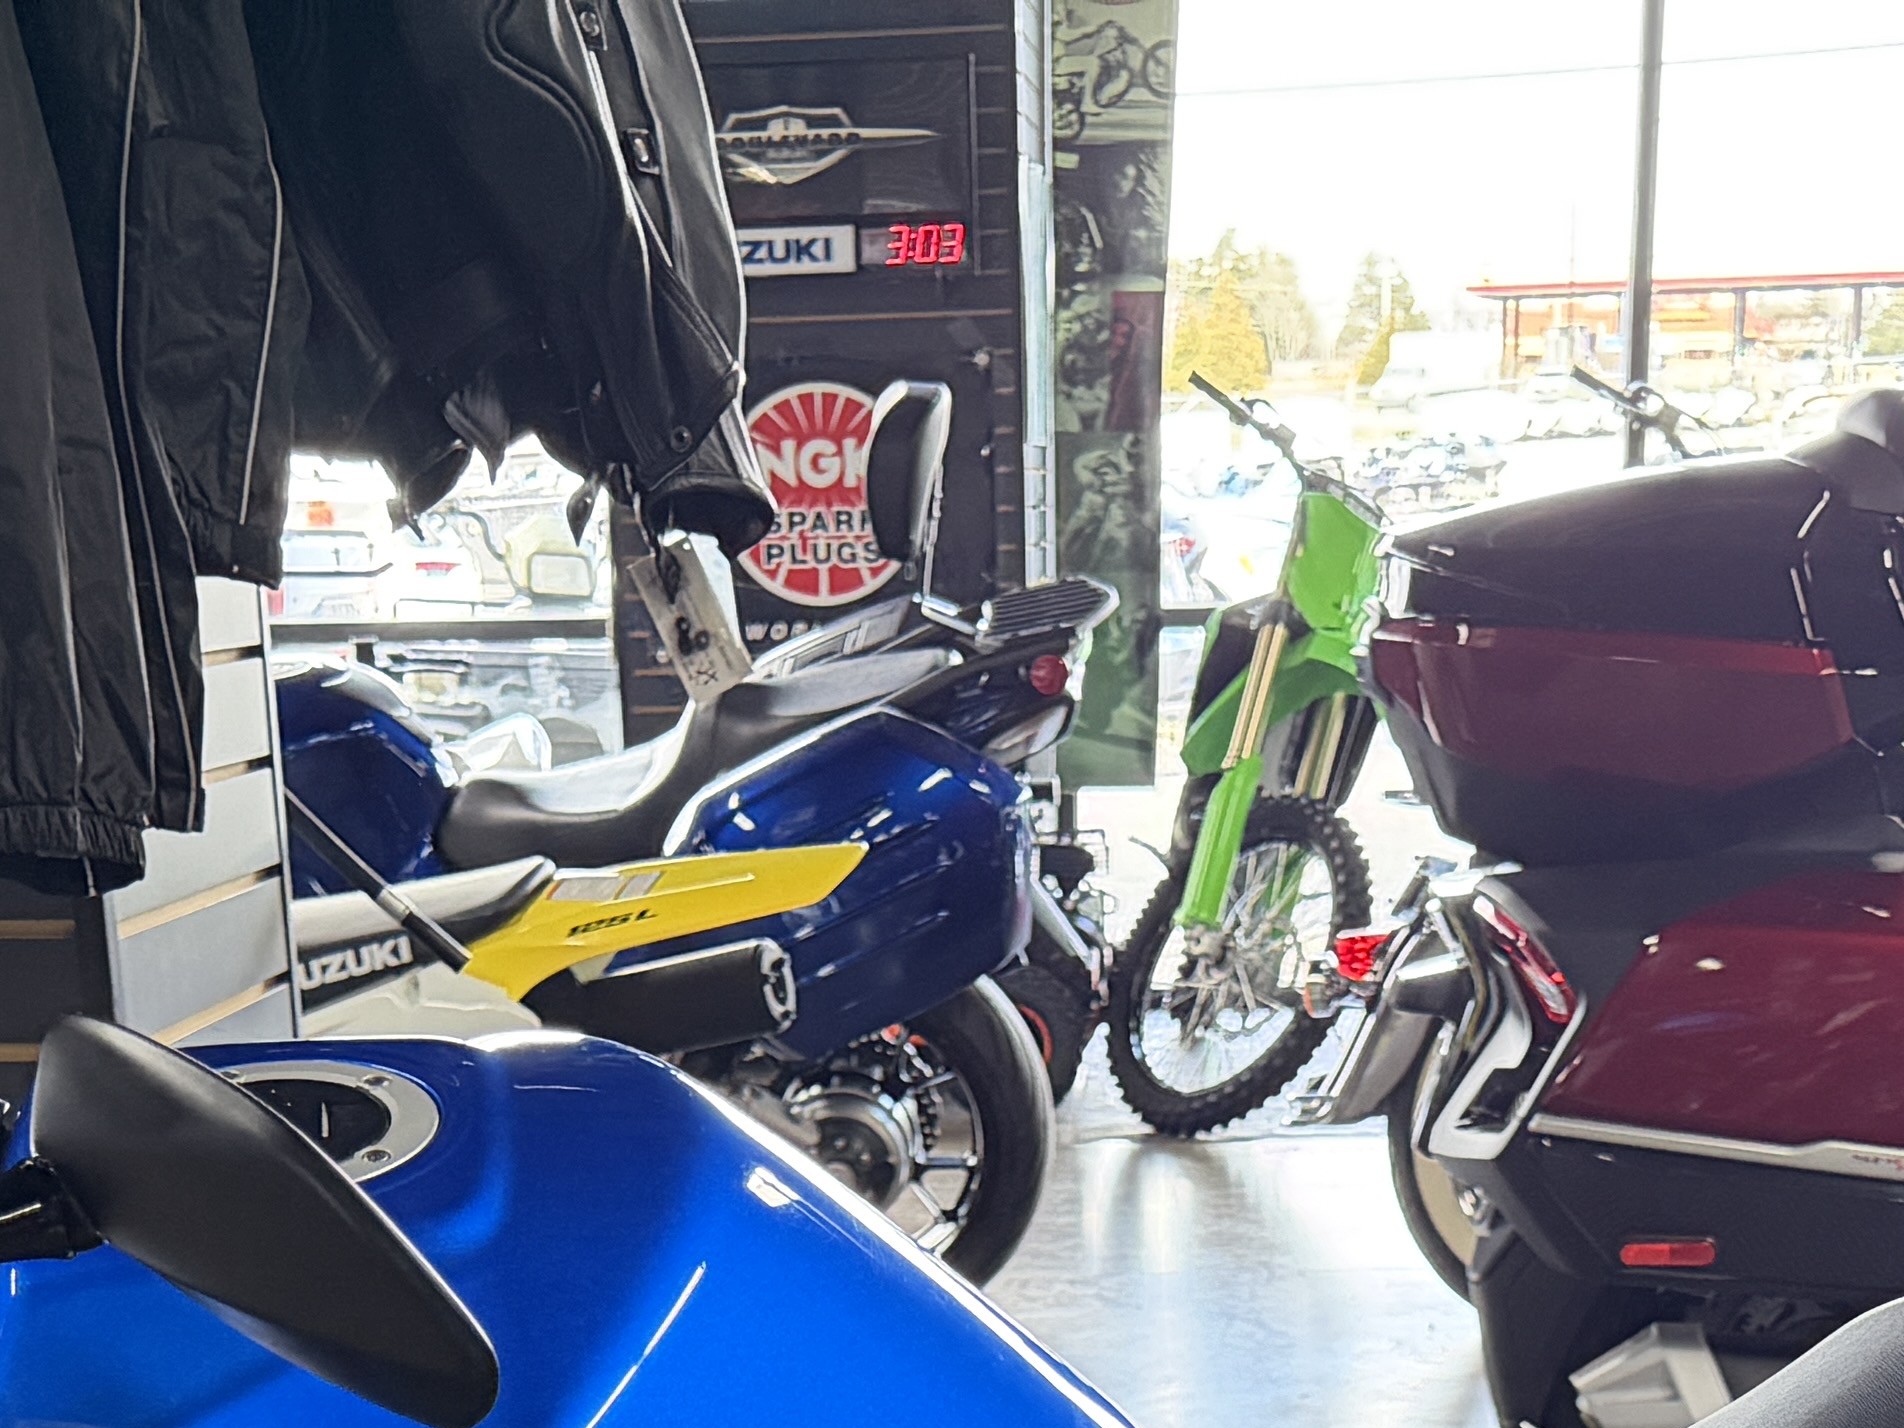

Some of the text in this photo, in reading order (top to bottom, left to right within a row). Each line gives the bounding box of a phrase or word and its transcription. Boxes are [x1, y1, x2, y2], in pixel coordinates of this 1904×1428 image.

[741, 237, 833, 264] ZUKI
[886, 223, 965, 267] 3:03
[765, 541, 883, 566] PLUGS
[296, 936, 414, 991] UZUKI
